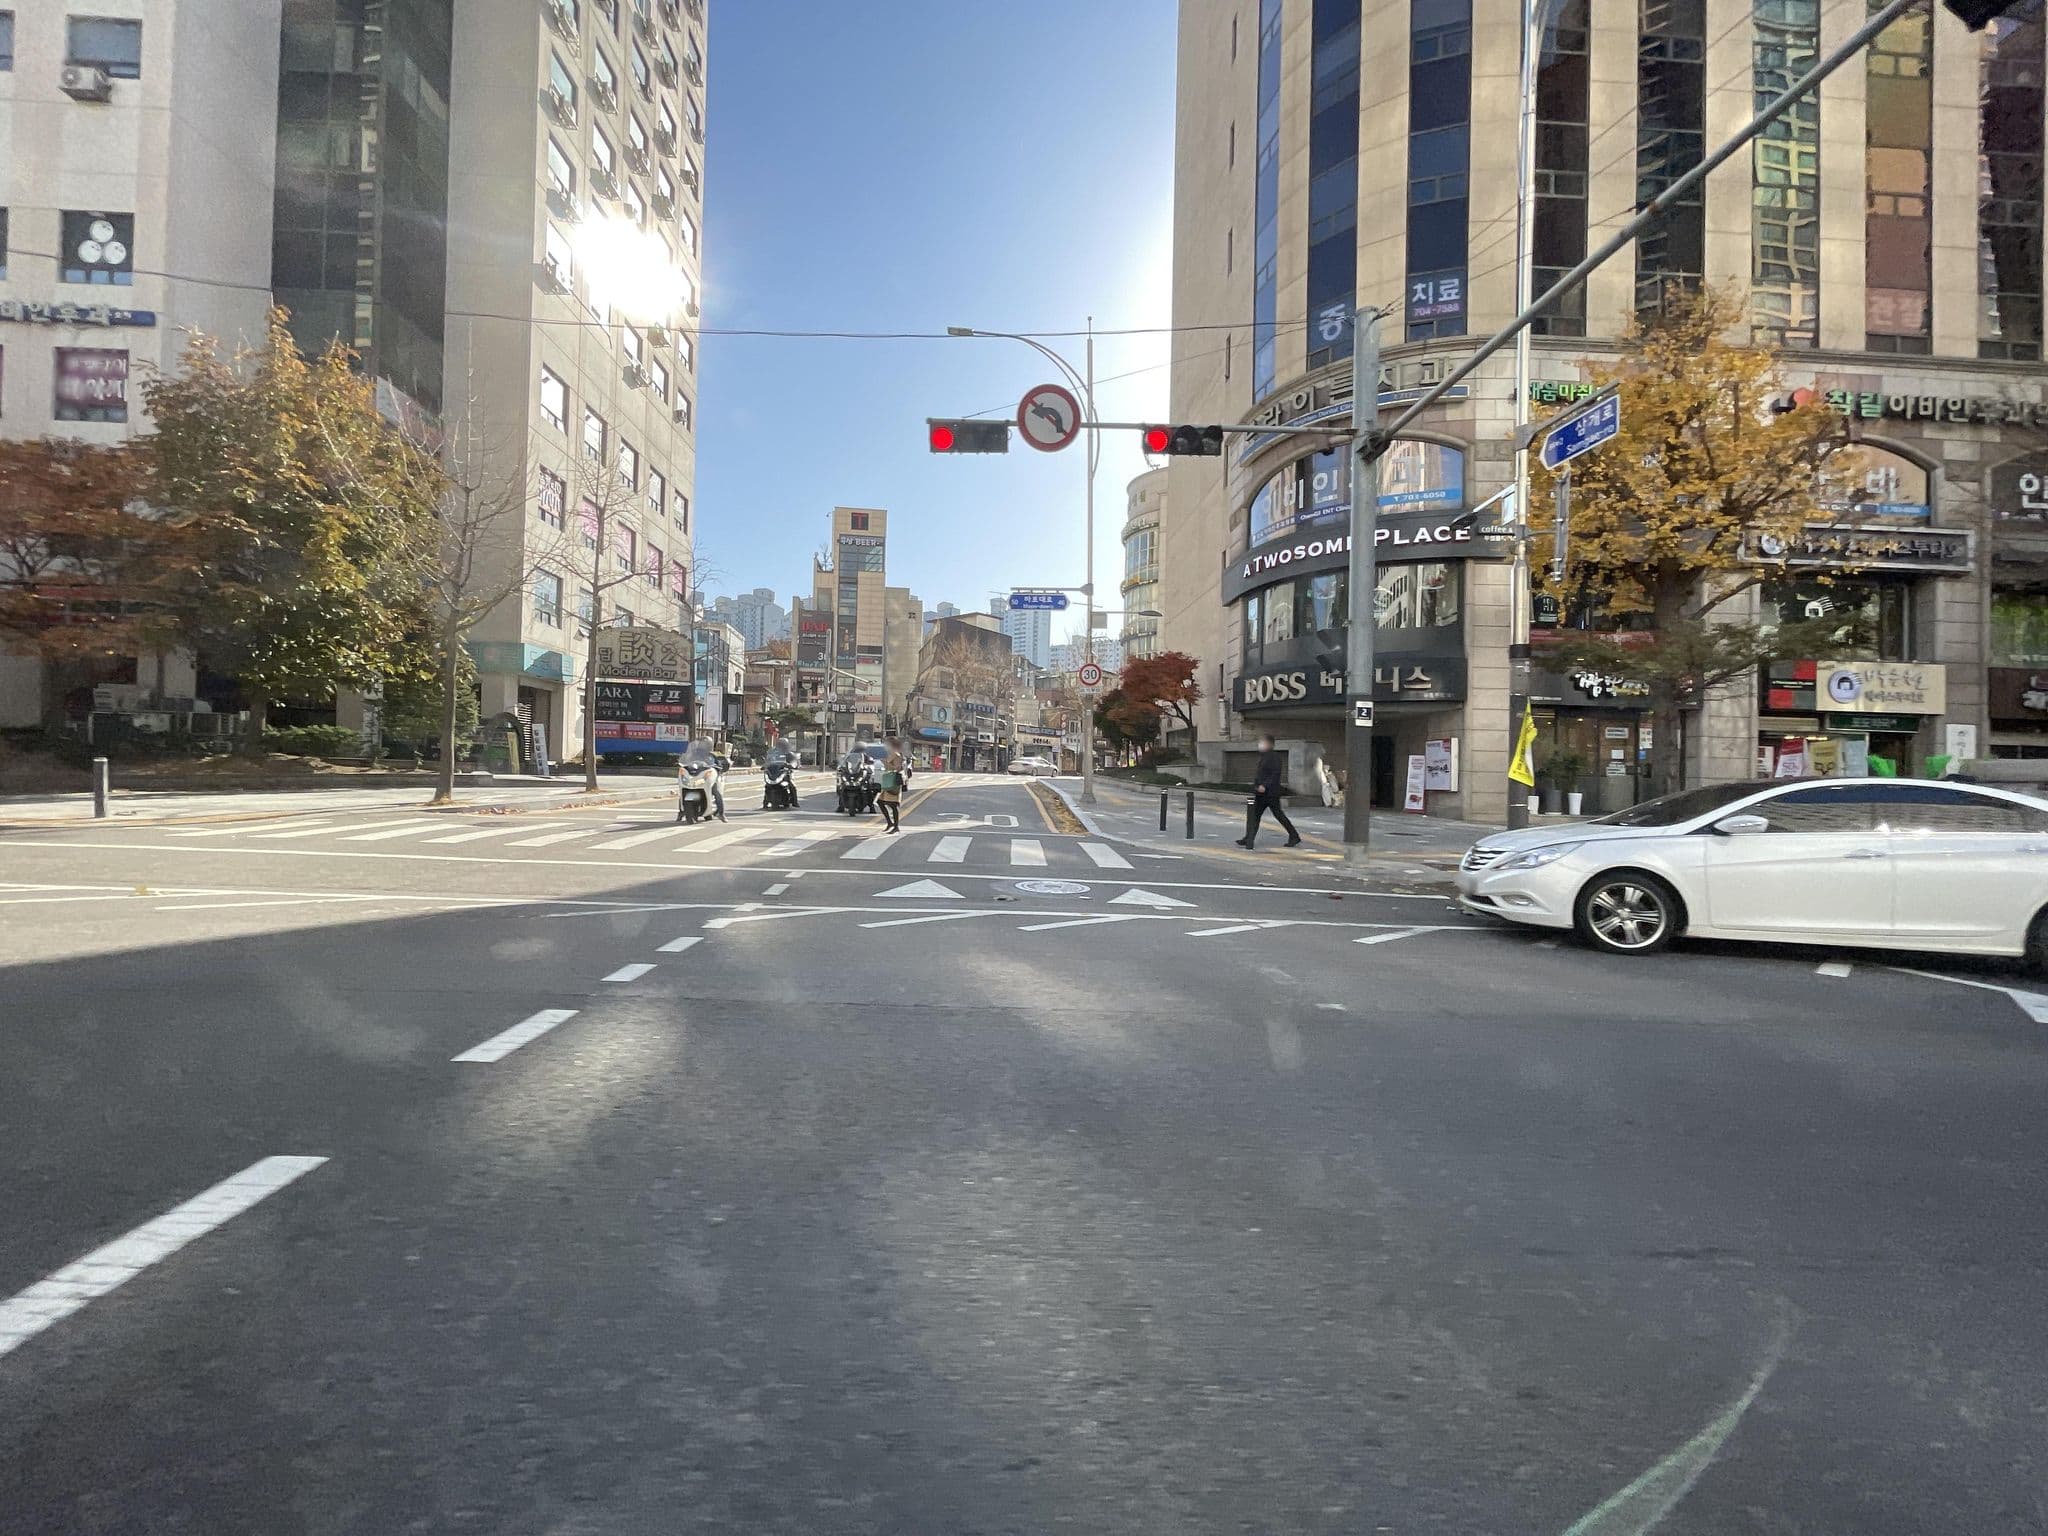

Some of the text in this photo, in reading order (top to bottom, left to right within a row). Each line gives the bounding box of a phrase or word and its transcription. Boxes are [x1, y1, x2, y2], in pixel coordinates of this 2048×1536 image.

[1412, 278, 1461, 304] 치료
[1575, 404, 1614, 437] 삼개로
[1481, 525, 1505, 533] coffee
[1243, 525, 1471, 579] A TWOSOM PLACE
[599, 664, 677, 679] Modern Bar
[1083, 669, 1097, 680] 30
[1244, 665, 1432, 703] BOSS 비니스
[648, 689, 681, 703] 골프
[1360, 708, 1368, 717] 2
[664, 726, 686, 737] 세탁
